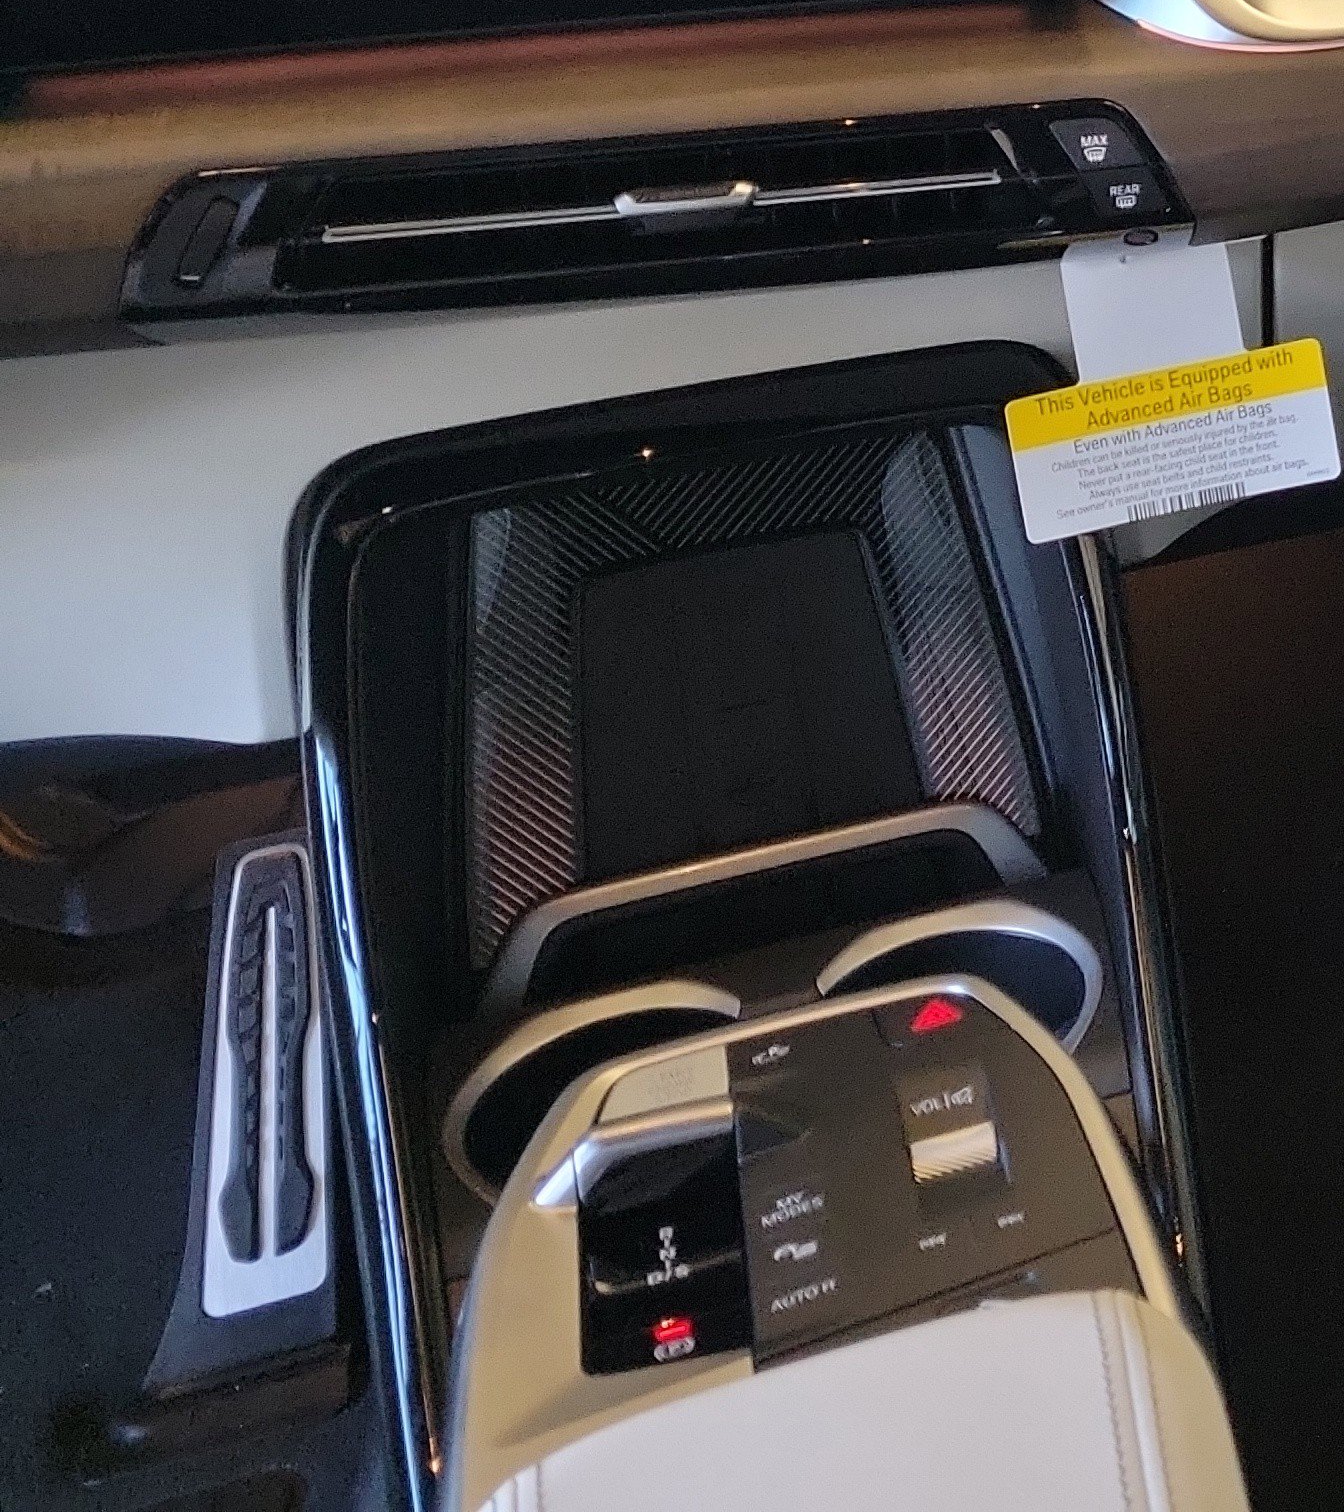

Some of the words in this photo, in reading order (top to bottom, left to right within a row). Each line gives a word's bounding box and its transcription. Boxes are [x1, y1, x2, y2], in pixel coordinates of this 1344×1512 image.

[1080, 134, 1109, 148] MAX
[1109, 182, 1142, 197] REAR
[1036, 396, 1074, 415] This
[1078, 380, 1145, 406] Vehicle
[1148, 375, 1164, 392] is
[1168, 358, 1252, 388] Equipped
[1257, 349, 1293, 369] with
[1087, 396, 1174, 427] Advanced
[1179, 390, 1202, 409] Air
[1207, 383, 1253, 404] Bags
[1074, 438, 1107, 452] Even
[1112, 429, 1140, 444] with
[1145, 413, 1211, 437] Advanced
[1216, 409, 1233, 422] Air
[1238, 404, 1271, 418] Bags
[1052, 458, 1090, 471] Children
[1077, 469, 1094, 477] The
[1098, 463, 1118, 473] back
[1152, 453, 1166, 461] the
